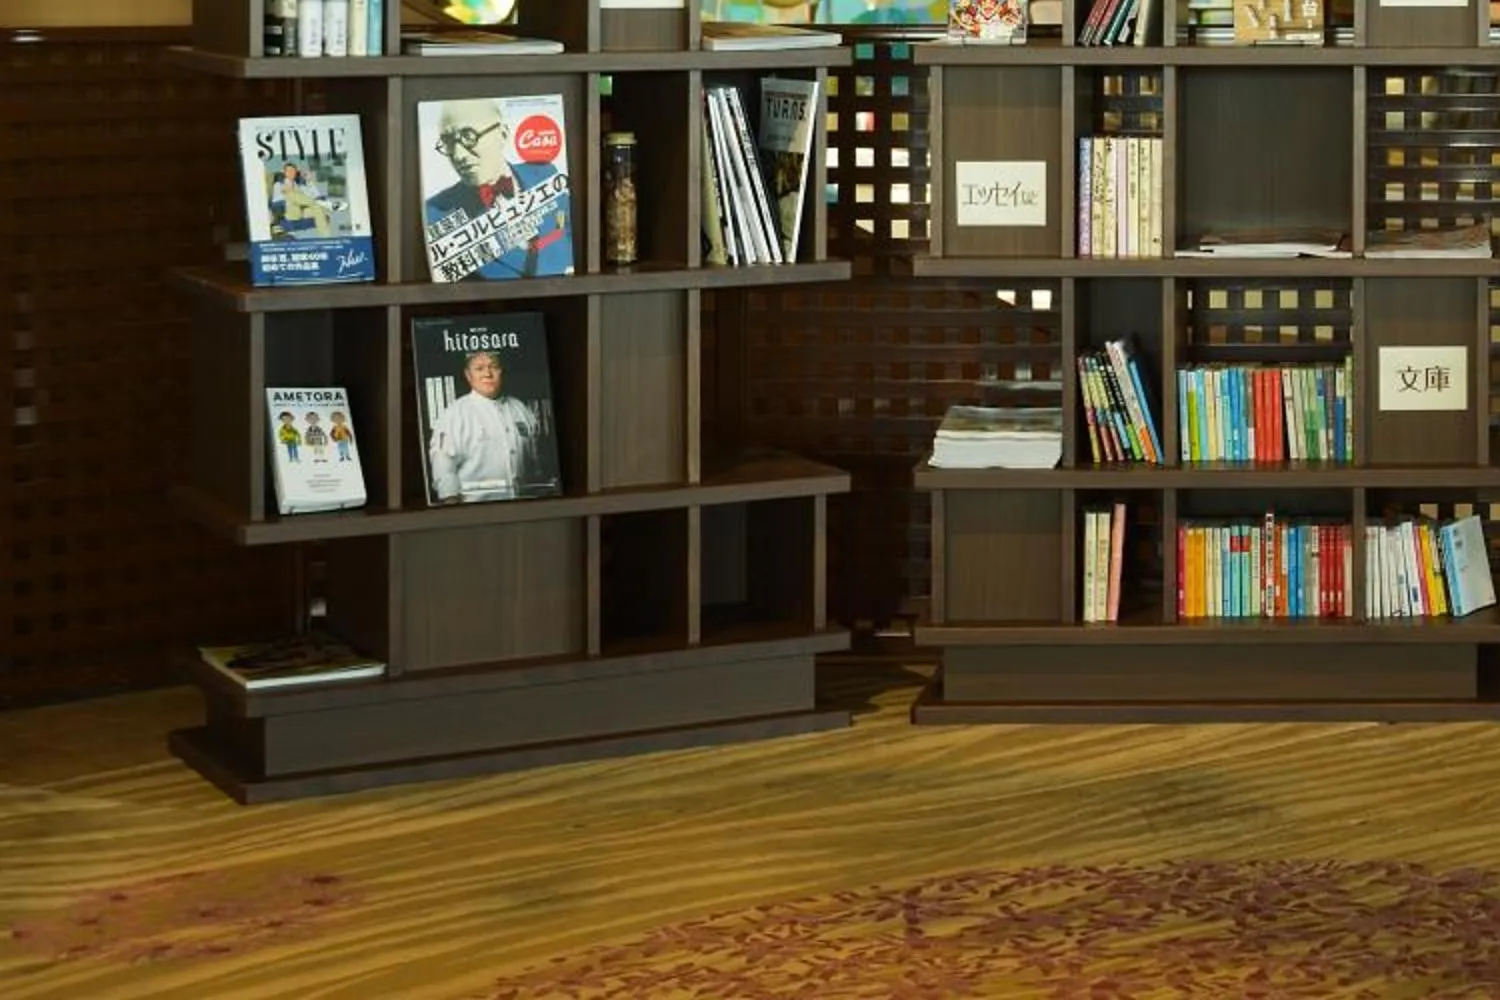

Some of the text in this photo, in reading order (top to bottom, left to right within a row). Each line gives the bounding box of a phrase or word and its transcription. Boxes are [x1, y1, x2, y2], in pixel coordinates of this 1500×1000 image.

[255, 128, 346, 161] STYLE
[443, 329, 520, 352] hitosara
[1396, 365, 1450, 393] 文庫
[273, 391, 345, 403] AMETORA
